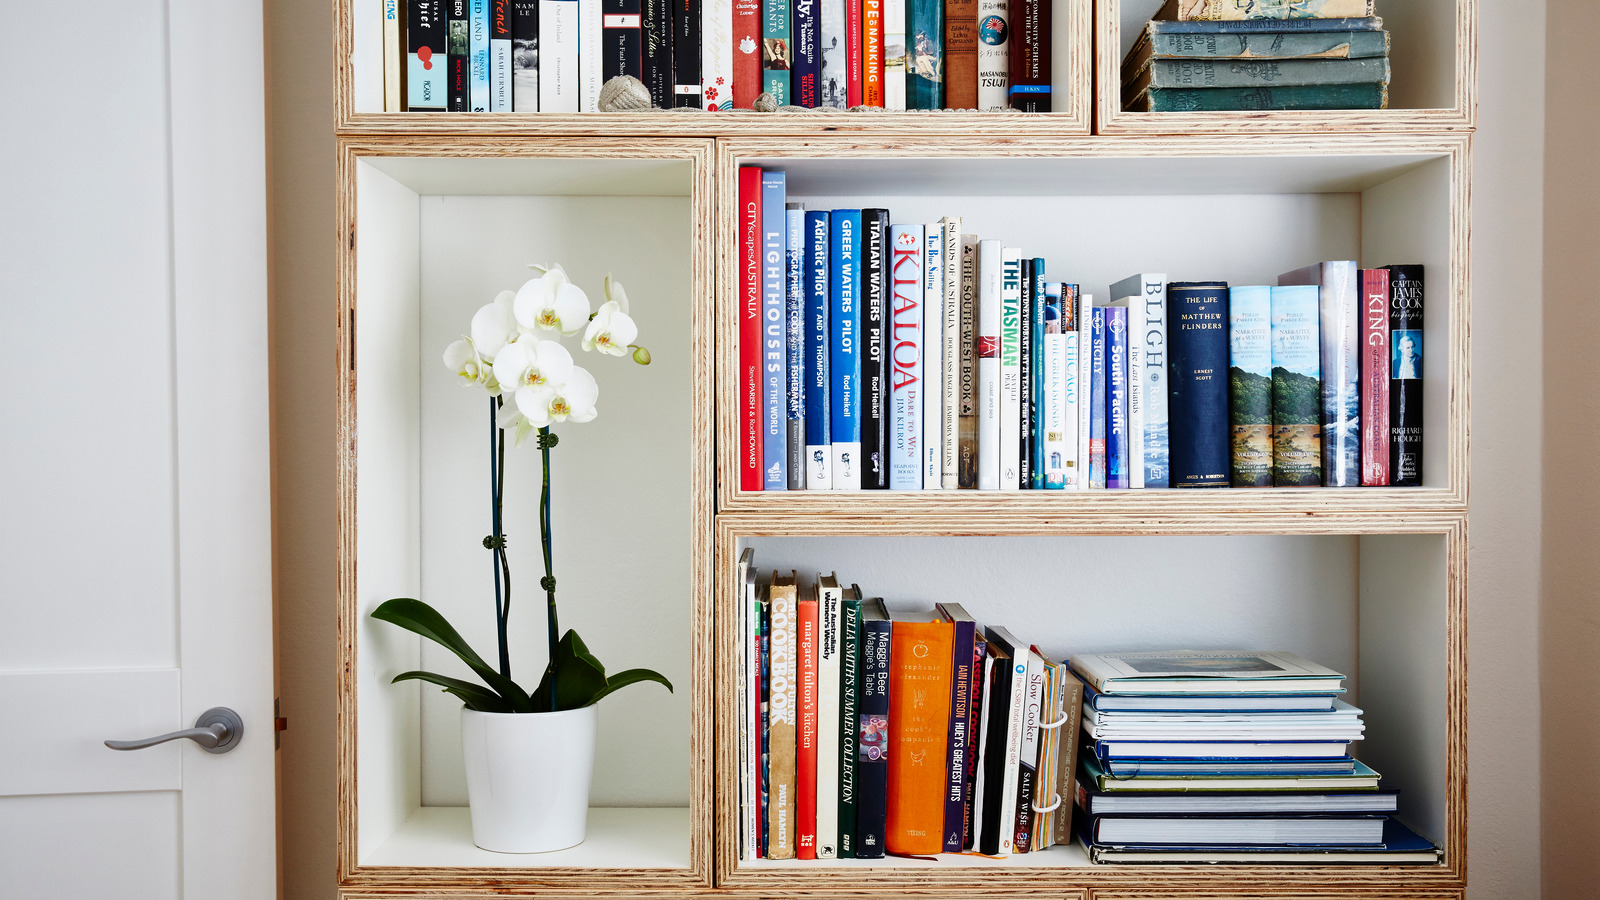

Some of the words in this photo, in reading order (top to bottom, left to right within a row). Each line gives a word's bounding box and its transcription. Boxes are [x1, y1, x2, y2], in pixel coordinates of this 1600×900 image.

[496, 0, 508, 34] French
[648, 30, 660, 58] Letters
[869, 28, 878, 82] NANKING
[1194, 36, 1204, 45] OF
[981, 78, 1006, 88] TSUJI
[1193, 62, 1203, 75] OF
[814, 218, 825, 266] Adriatic
[842, 220, 852, 260] GREEK
[870, 220, 880, 268] ITALIAN
[928, 250, 939, 265] Blue
[746, 202, 756, 320] CITYscapesAUSTRALIA
[928, 266, 938, 290] Sailing
[963, 258, 972, 282] THE
[1004, 258, 1020, 290] THE
[814, 268, 825, 296] Pilot
[842, 262, 852, 313] WATERS
[870, 272, 880, 322] WATERS
[1394, 288, 1422, 298] JAMES
[767, 232, 780, 373] LIGHTHOUSES
[893, 246, 920, 392] KIALOA
[1368, 293, 1384, 346] KING
[1392, 298, 1422, 308] COOK
[842, 320, 852, 354] PILOT
[962, 286, 972, 364] SOUTH-WEST
[1004, 296, 1020, 366] TASMAN
[1146, 281, 1163, 370] BLIGH
[870, 328, 880, 362] PILOT
[1094, 338, 1102, 374] SICILY
[1132, 346, 1140, 362] The
[962, 366, 972, 400] BOOK
[1066, 336, 1078, 404] CHICAGO
[1112, 345, 1124, 386] South
[770, 390, 778, 404] THE
[791, 366, 799, 412] FISHERMAN
[896, 398, 904, 413] JIM
[1132, 385, 1140, 414] Islands
[770, 406, 778, 435] WORLD
[1112, 390, 1124, 435] Pacific
[896, 416, 904, 450] KILROY
[788, 600, 796, 619] THE
[846, 607, 856, 640] DELIA
[772, 598, 788, 726] COOKBOOK
[788, 622, 796, 682] MARGARET
[802, 621, 813, 668] margaret
[865, 632, 876, 670] Maggie's
[876, 632, 888, 668] Maggie
[845, 642, 856, 686] SMITH'S
[958, 665, 968, 680] IAIN
[970, 646, 982, 708] CASSEROLE
[804, 671, 814, 710] fulton's
[865, 673, 875, 696] Table
[878, 672, 888, 696] Beer
[956, 680, 967, 718] HEWITSON
[1030, 674, 1041, 700] Slow
[788, 684, 796, 726] FULTON
[844, 687, 854, 735] SUMMER
[1026, 703, 1038, 742] Cooker
[804, 712, 814, 748] kitchen
[954, 722, 965, 748] HUEY'S
[1010, 724, 1019, 752] wellbeing
[1066, 705, 1077, 764] COMMONSENSE
[842, 737, 854, 804] COLLECTION
[952, 750, 963, 784] GREATEST
[1062, 766, 1070, 803] COOKERY
[778, 784, 786, 808] PAUL
[950, 786, 962, 802] HITS
[1022, 772, 1030, 799] SALLY
[778, 809, 786, 849] HAMLYN
[1020, 802, 1028, 825] WISE
